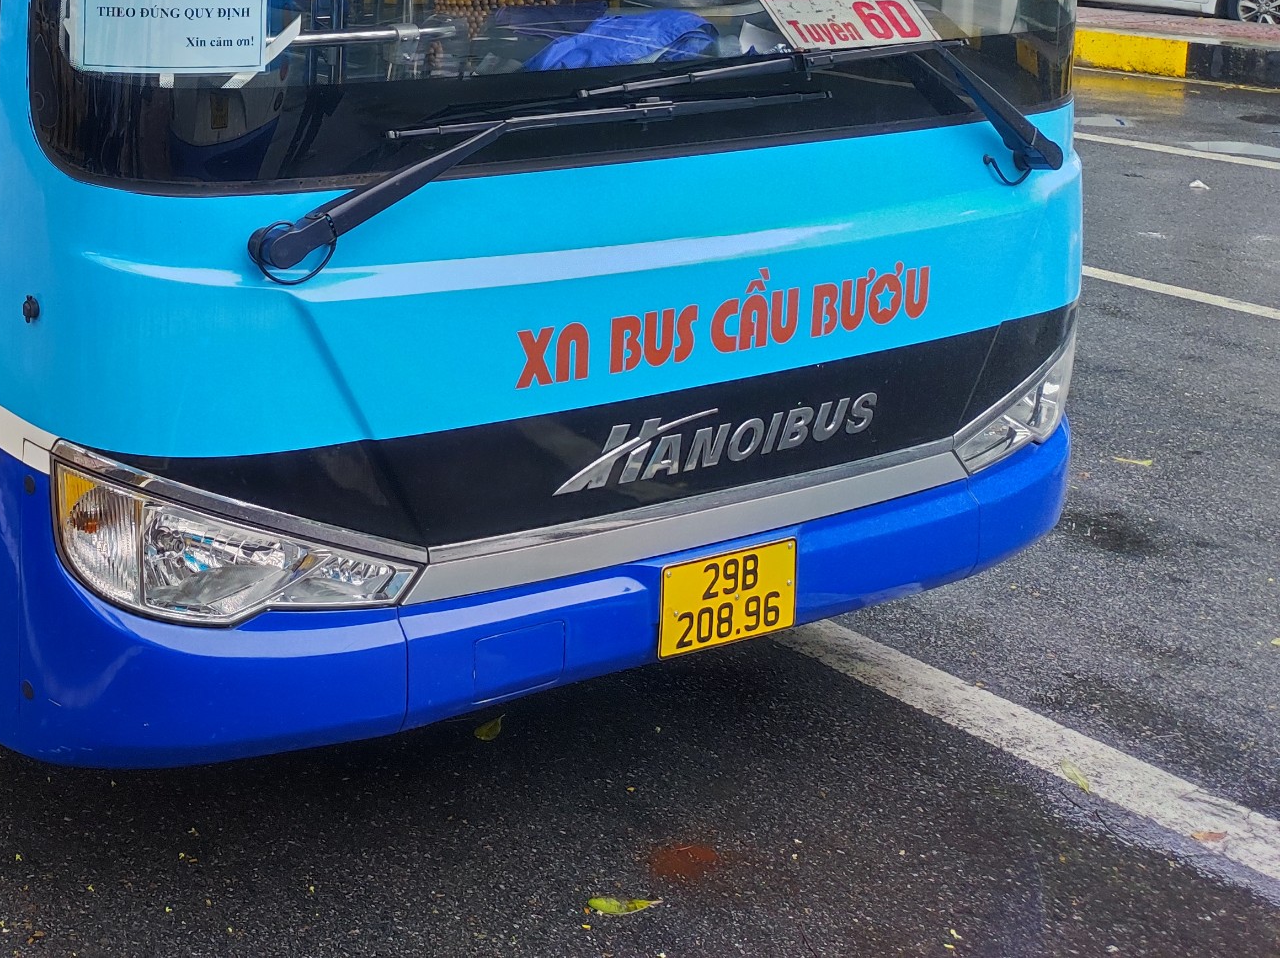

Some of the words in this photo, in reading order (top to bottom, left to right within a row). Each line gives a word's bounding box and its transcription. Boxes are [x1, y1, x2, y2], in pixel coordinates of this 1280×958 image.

[96, 6, 136, 18] THEO
[140, 4, 180, 19] ĐÚNG
[184, 7, 215, 21] QUY
[217, 7, 251, 21] ĐỊNH
[786, 14, 865, 45] Tuyến
[852, 0, 922, 40] 6D
[185, 36, 207, 48] Xin
[236, 35, 254, 47] ơn!
[515, 321, 589, 390] XN
[608, 304, 698, 375] BUS
[710, 267, 800, 354] CẦU
[552, 392, 879, 497] HANOIBUS
[702, 554, 759, 601] 29B
[675, 591, 780, 649] 208.96
